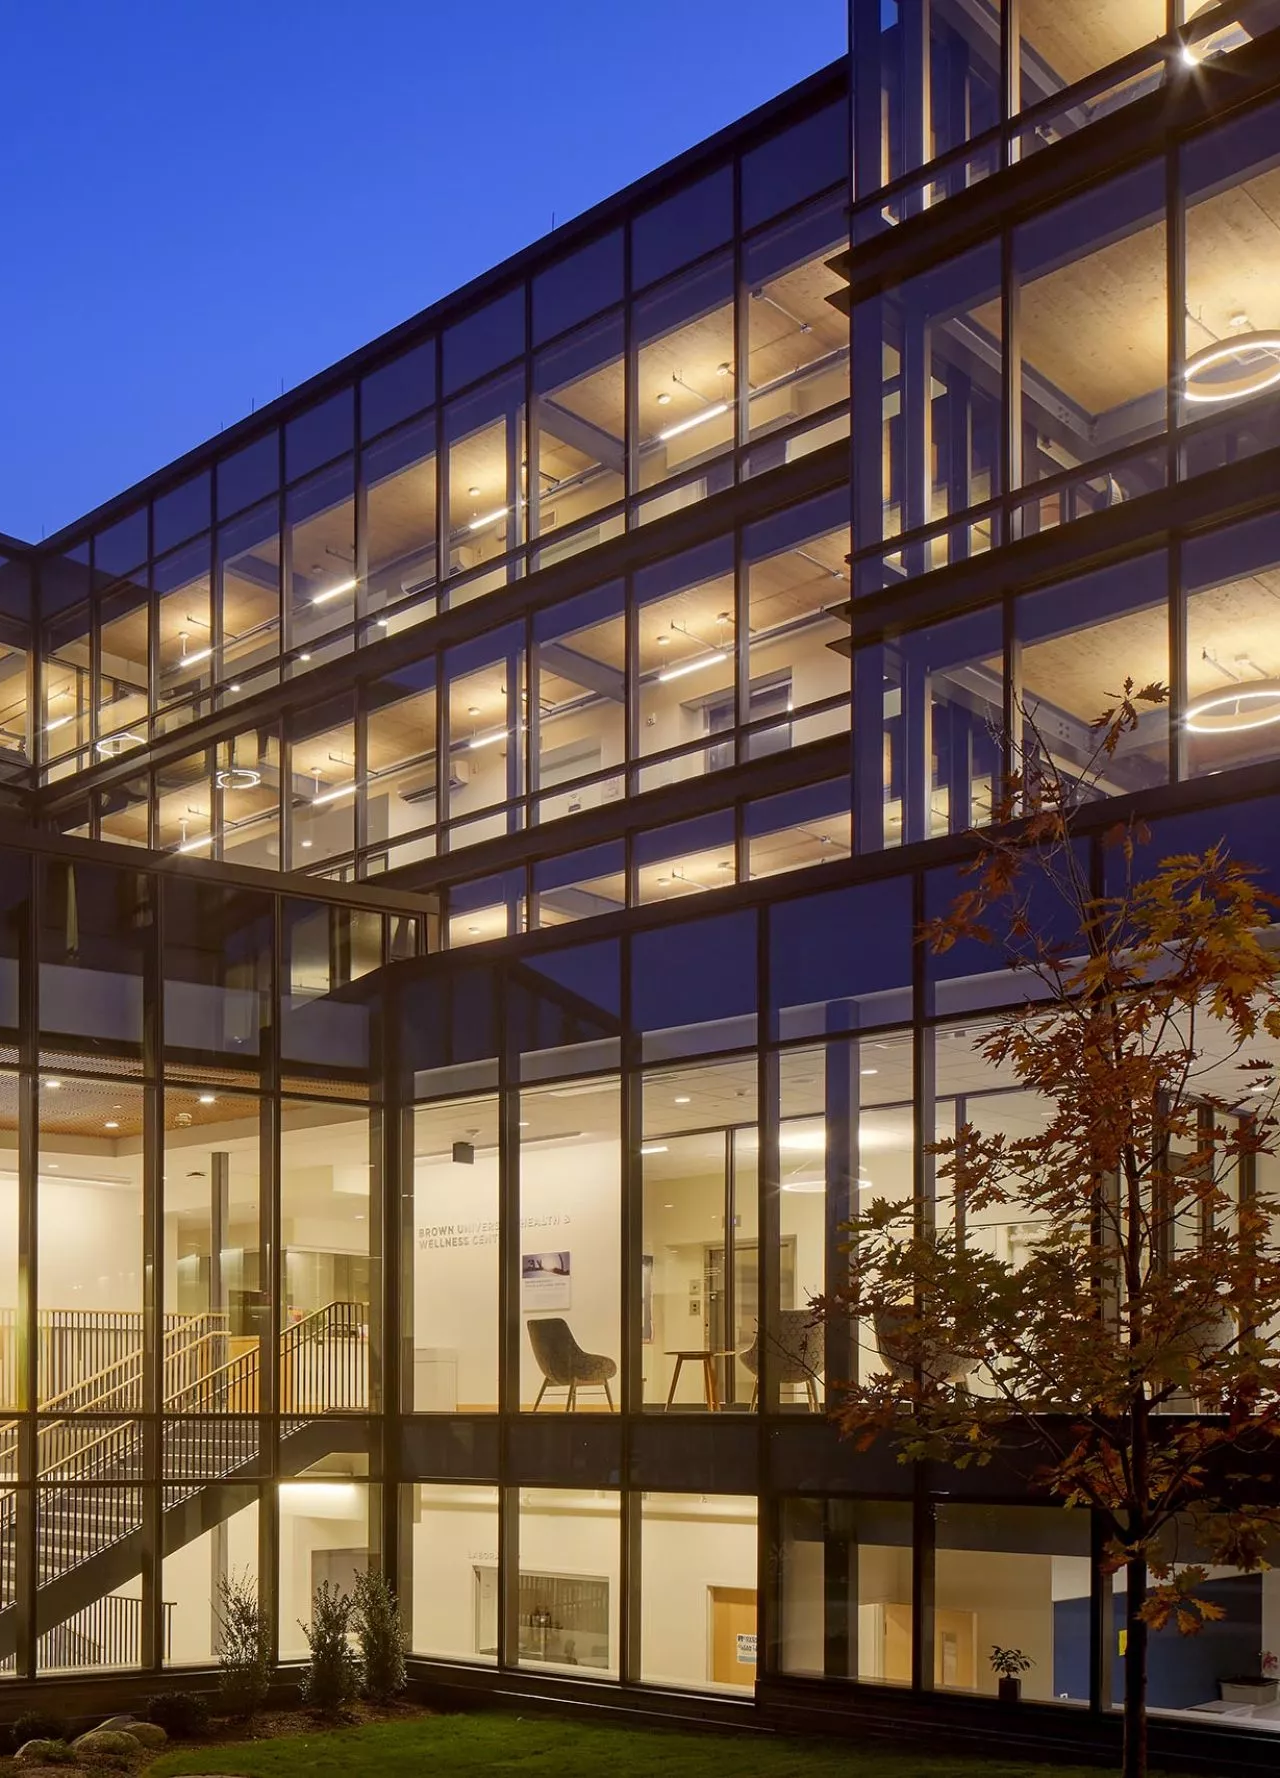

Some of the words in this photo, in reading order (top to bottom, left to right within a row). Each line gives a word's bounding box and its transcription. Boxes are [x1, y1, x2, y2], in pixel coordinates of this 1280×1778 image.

[418, 1225, 455, 1238] BROWN
[457, 1221, 499, 1235] UNIVERS
[418, 1236, 470, 1250] WELLNESS
[472, 1233, 499, 1246] CENT
